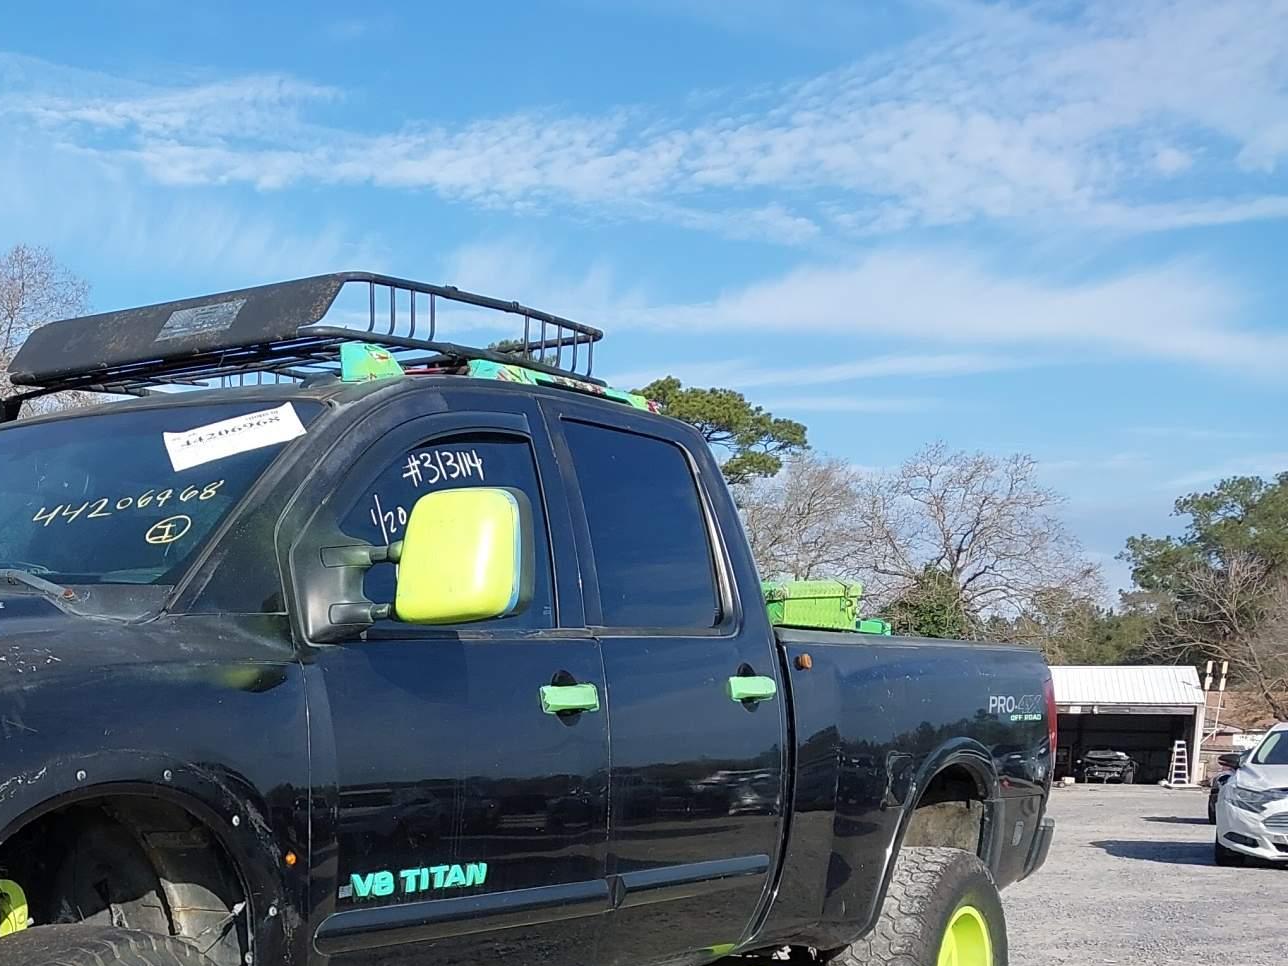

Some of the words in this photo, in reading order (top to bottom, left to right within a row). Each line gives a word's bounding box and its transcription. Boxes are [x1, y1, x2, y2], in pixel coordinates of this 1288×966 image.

[402, 449, 484, 487] #313114
[32, 479, 225, 527] 44206968
[1010, 713, 1023, 721] OFF
[1024, 713, 1042, 721] ROAD
[351, 870, 395, 898] V8
[399, 862, 488, 894] TITAN
